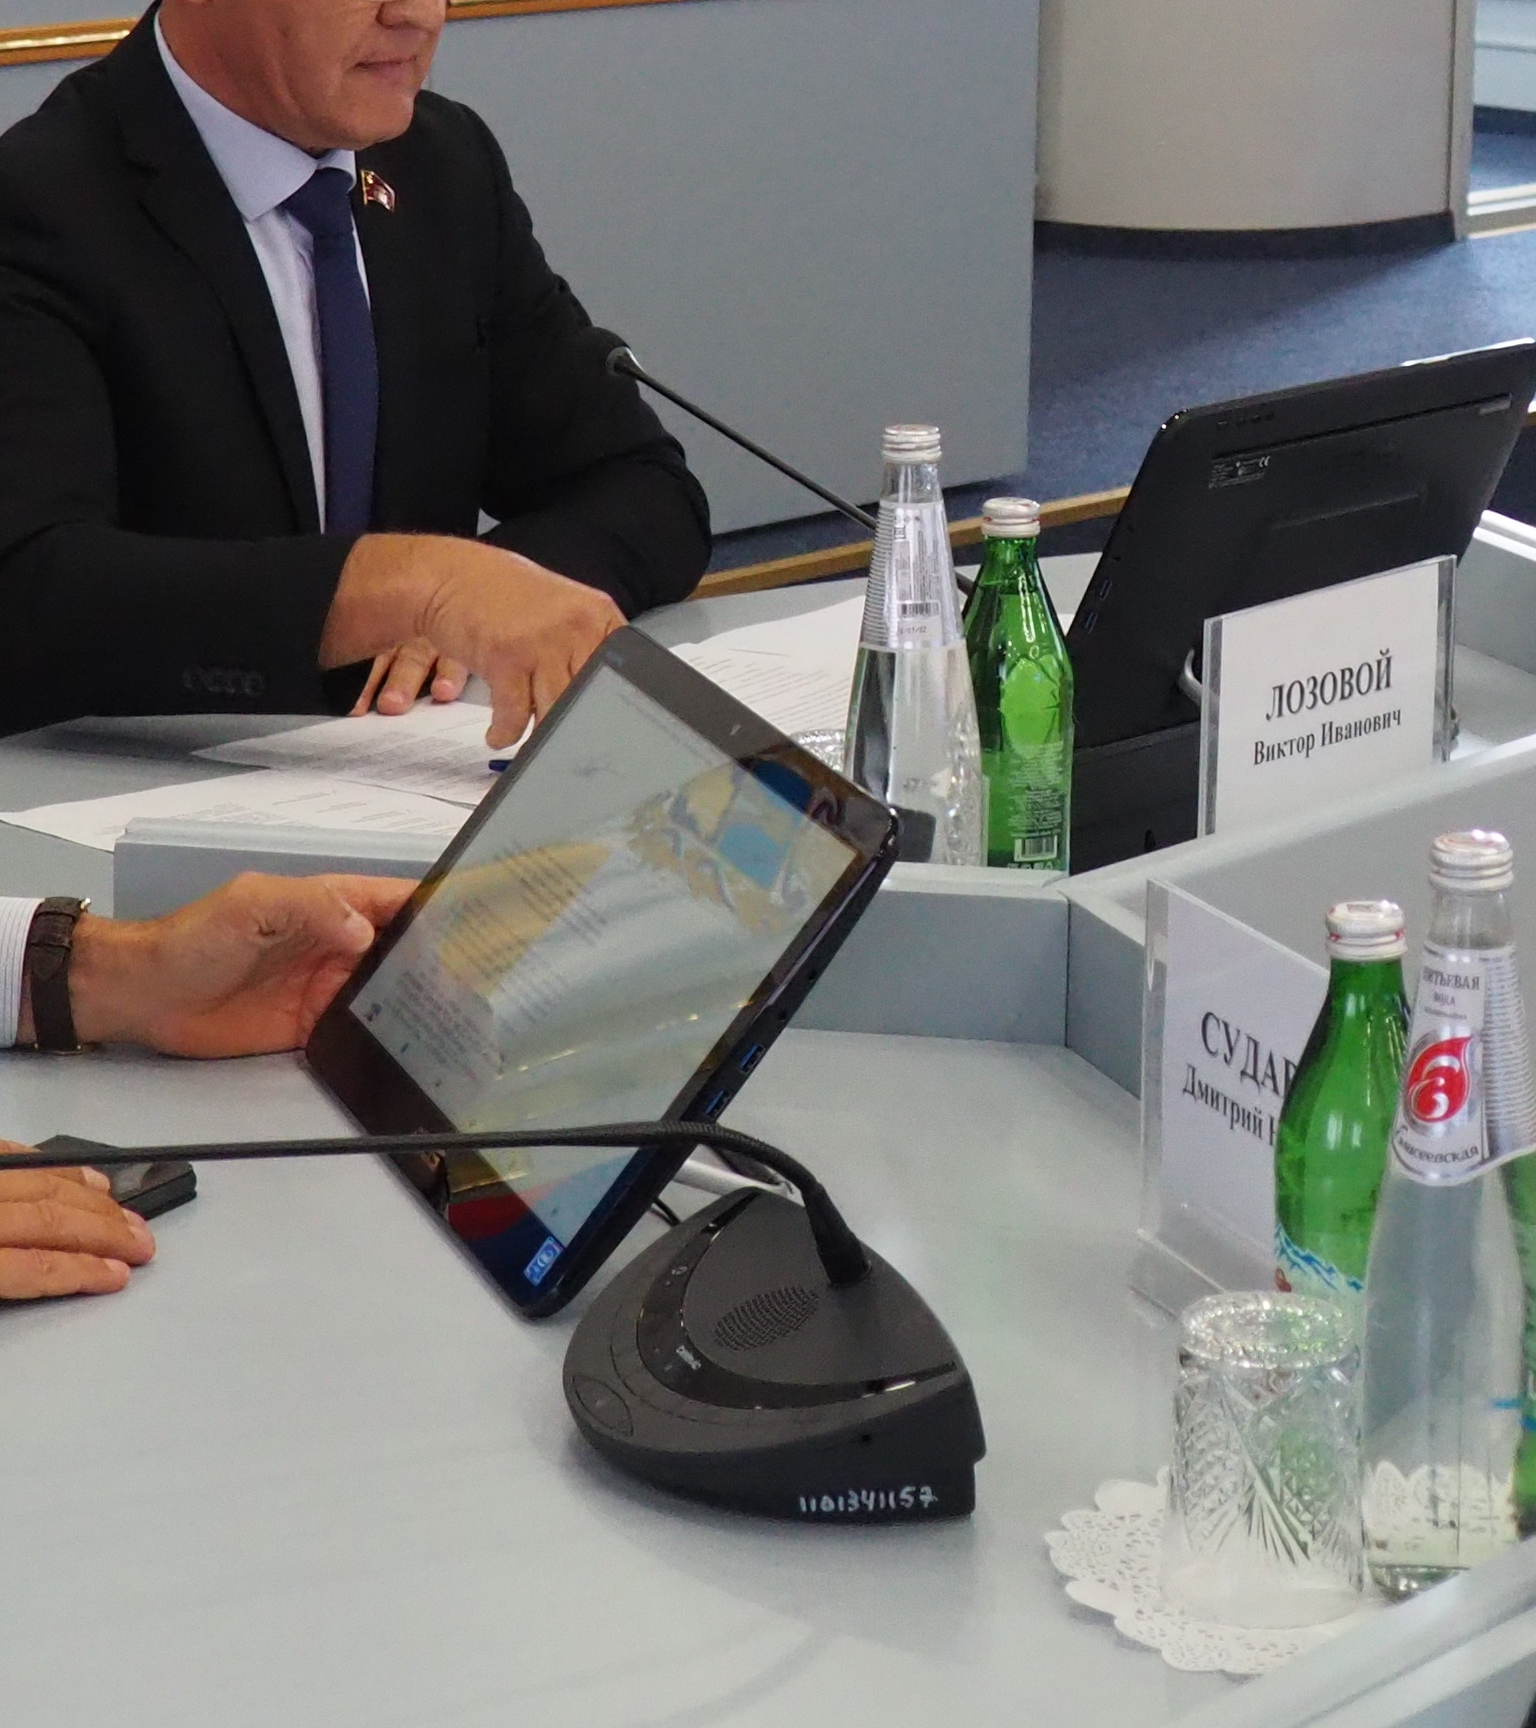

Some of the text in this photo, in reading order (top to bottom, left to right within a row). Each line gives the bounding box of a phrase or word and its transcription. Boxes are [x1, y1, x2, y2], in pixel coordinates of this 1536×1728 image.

[1265, 648, 1393, 722] ЛОЗОВОЙ
[1253, 709, 1402, 766] Виктор Иванович
[1182, 1063, 1263, 1139] Дмитрий
